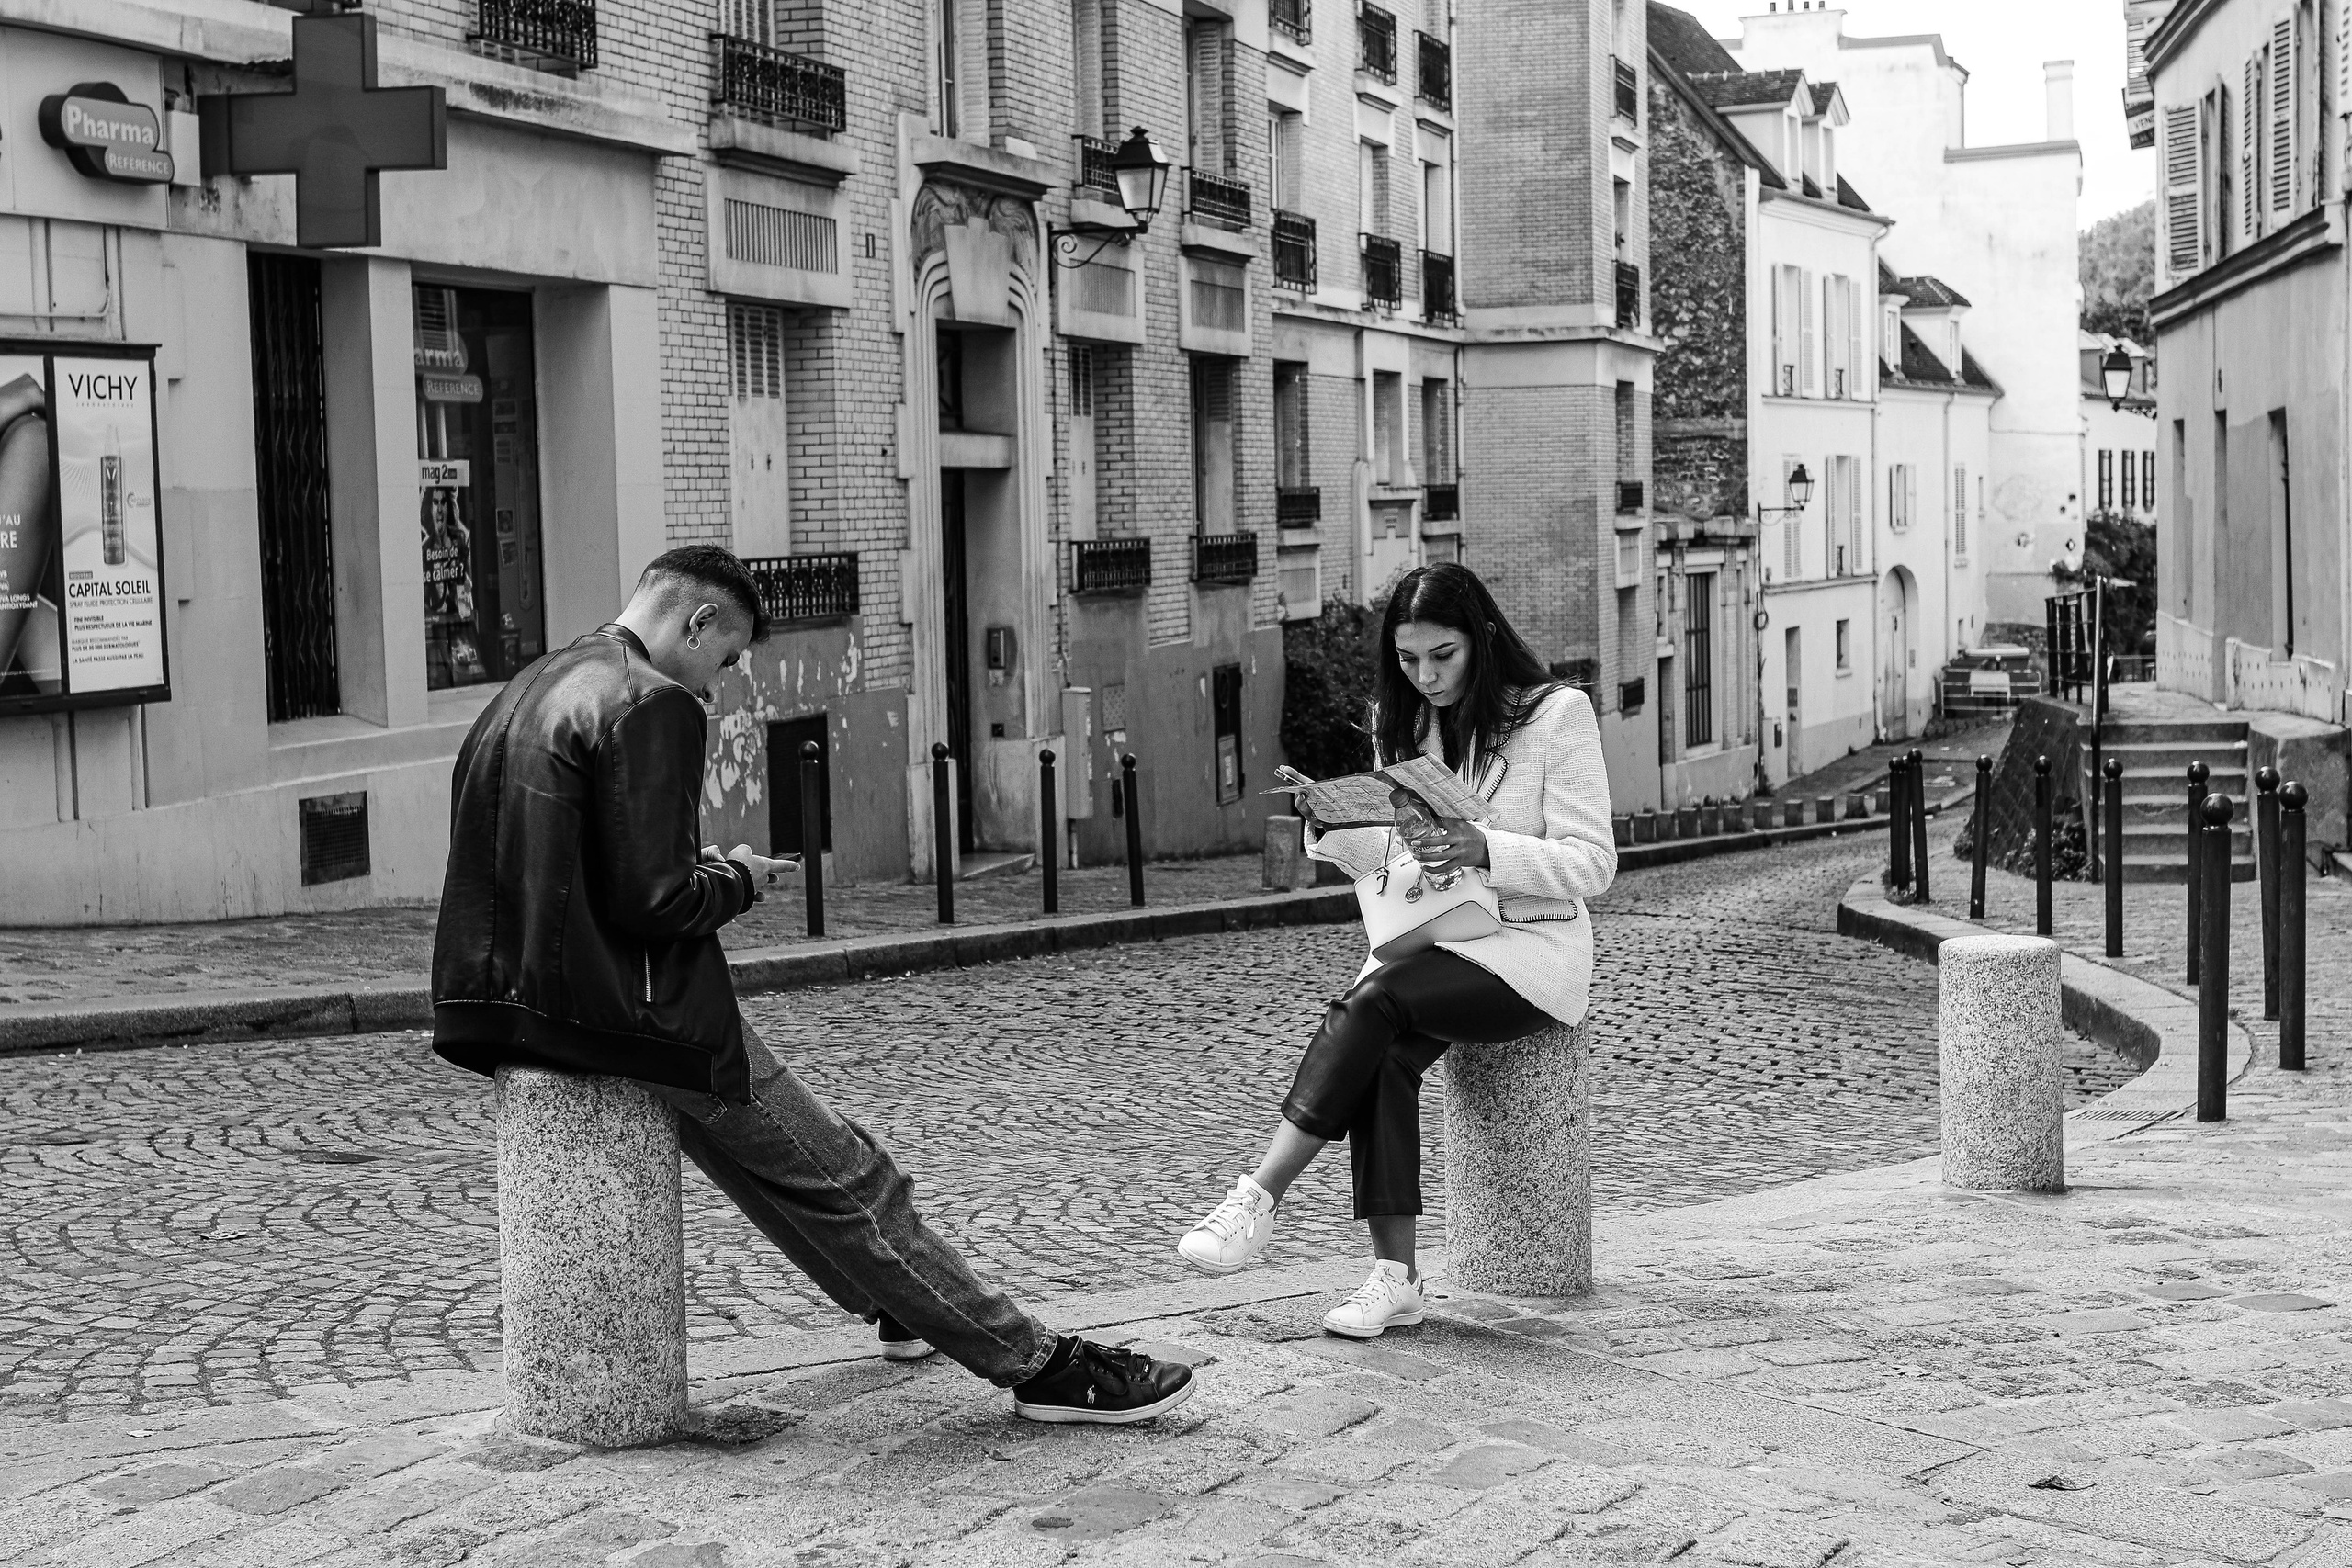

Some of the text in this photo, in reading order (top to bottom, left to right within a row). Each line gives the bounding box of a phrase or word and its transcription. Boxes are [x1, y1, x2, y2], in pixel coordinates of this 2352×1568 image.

[66, 104, 155, 145] Pharma
[108, 152, 169, 175] REFERENCE
[68, 373, 138, 400] VICHY
[422, 466, 440, 485] mag
[0, 513, 20, 526] 'AU
[426, 545, 458, 561] Besoin de
[433, 565, 458, 581] calmer
[69, 580, 151, 598] CAPITAL SOLEIL
